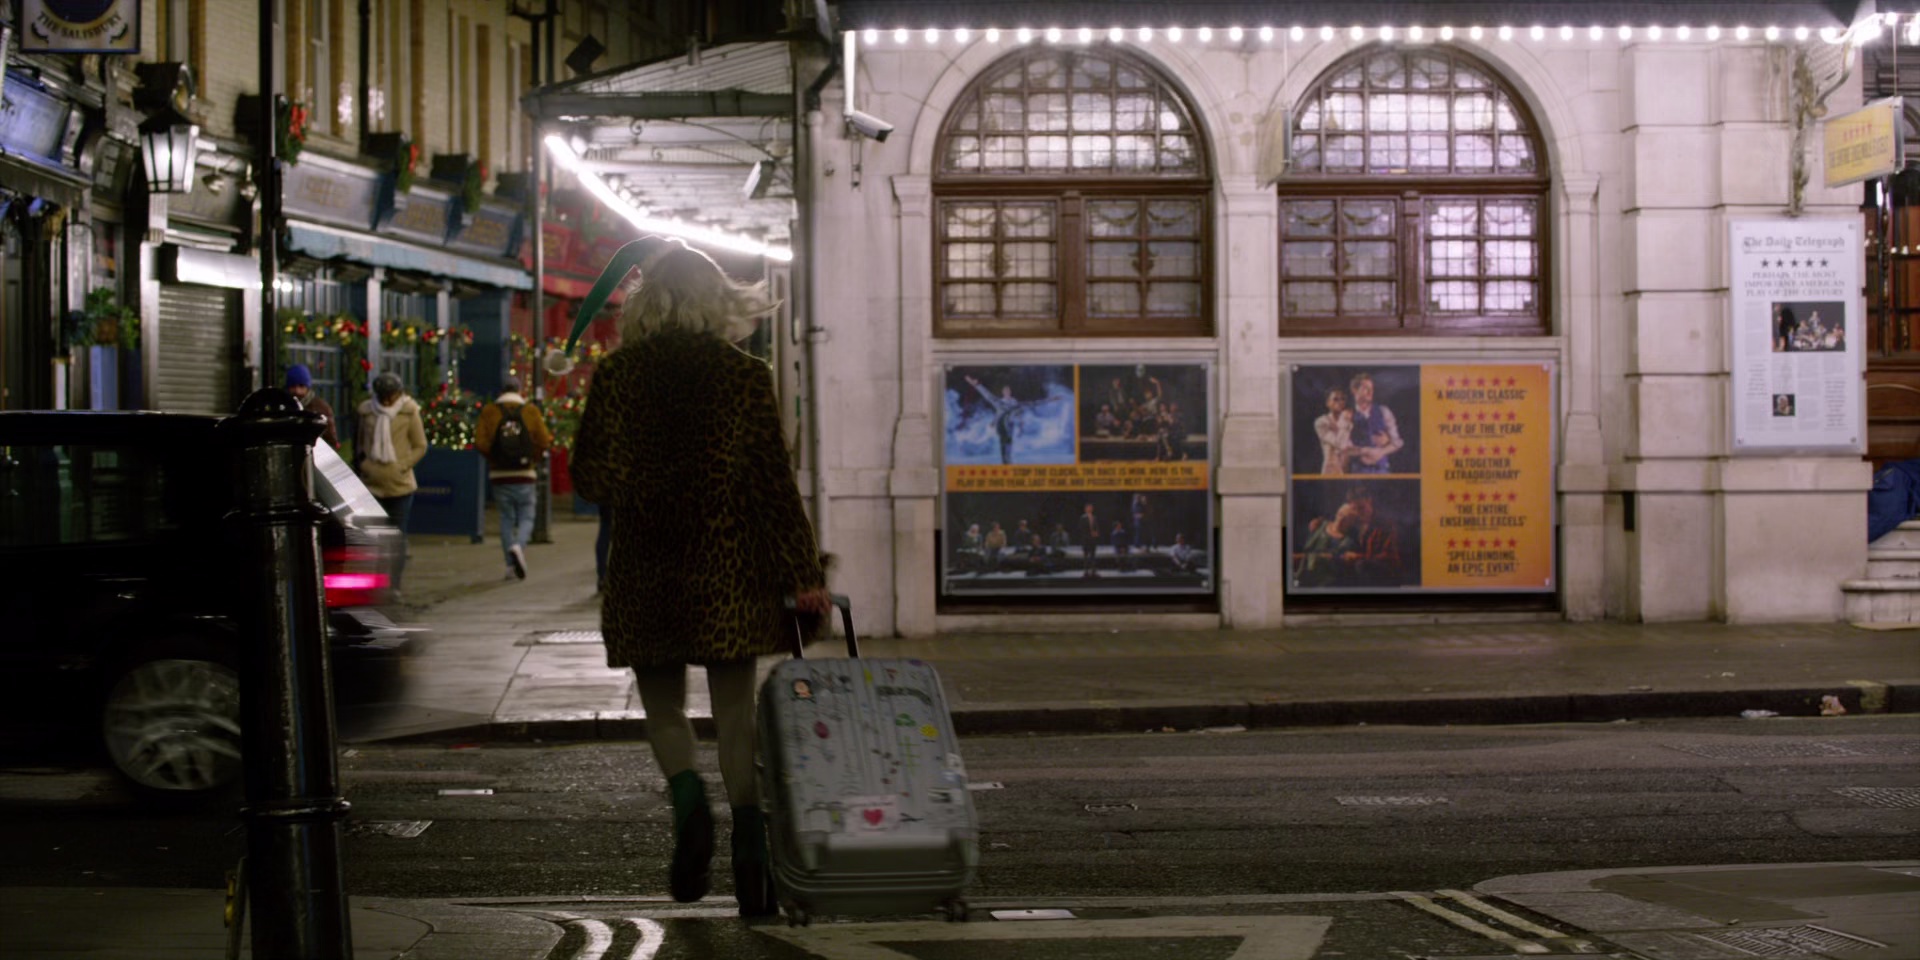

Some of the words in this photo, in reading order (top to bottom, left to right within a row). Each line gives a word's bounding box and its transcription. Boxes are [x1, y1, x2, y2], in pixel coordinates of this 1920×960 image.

[37, 10, 60, 33] THE
[61, 10, 122, 39] SALISBURY
[1744, 236, 1762, 247] The
[1765, 236, 1793, 249] Daily
[1795, 236, 1845, 249] Telegraph
[1752, 271, 1790, 279] PERHAPS
[1744, 280, 1796, 288] IMPORTANT
[1800, 280, 1845, 288] AMERICAN
[1746, 288, 1766, 297] PLAY
[1768, 289, 1780, 297] OF
[1783, 289, 1799, 297] THE
[1802, 289, 1843, 297] CENTURY
[1446, 389, 1485, 400] MODERN
[1465, 424, 1477, 434] OF
[1480, 424, 1495, 434] THE
[956, 479, 974, 487] PLAY
[1476, 504, 1508, 514] ENTIRE
[1440, 516, 1487, 527] ENSEMBLE
[1447, 562, 1460, 573] AN
[1462, 562, 1484, 573] EPIC
